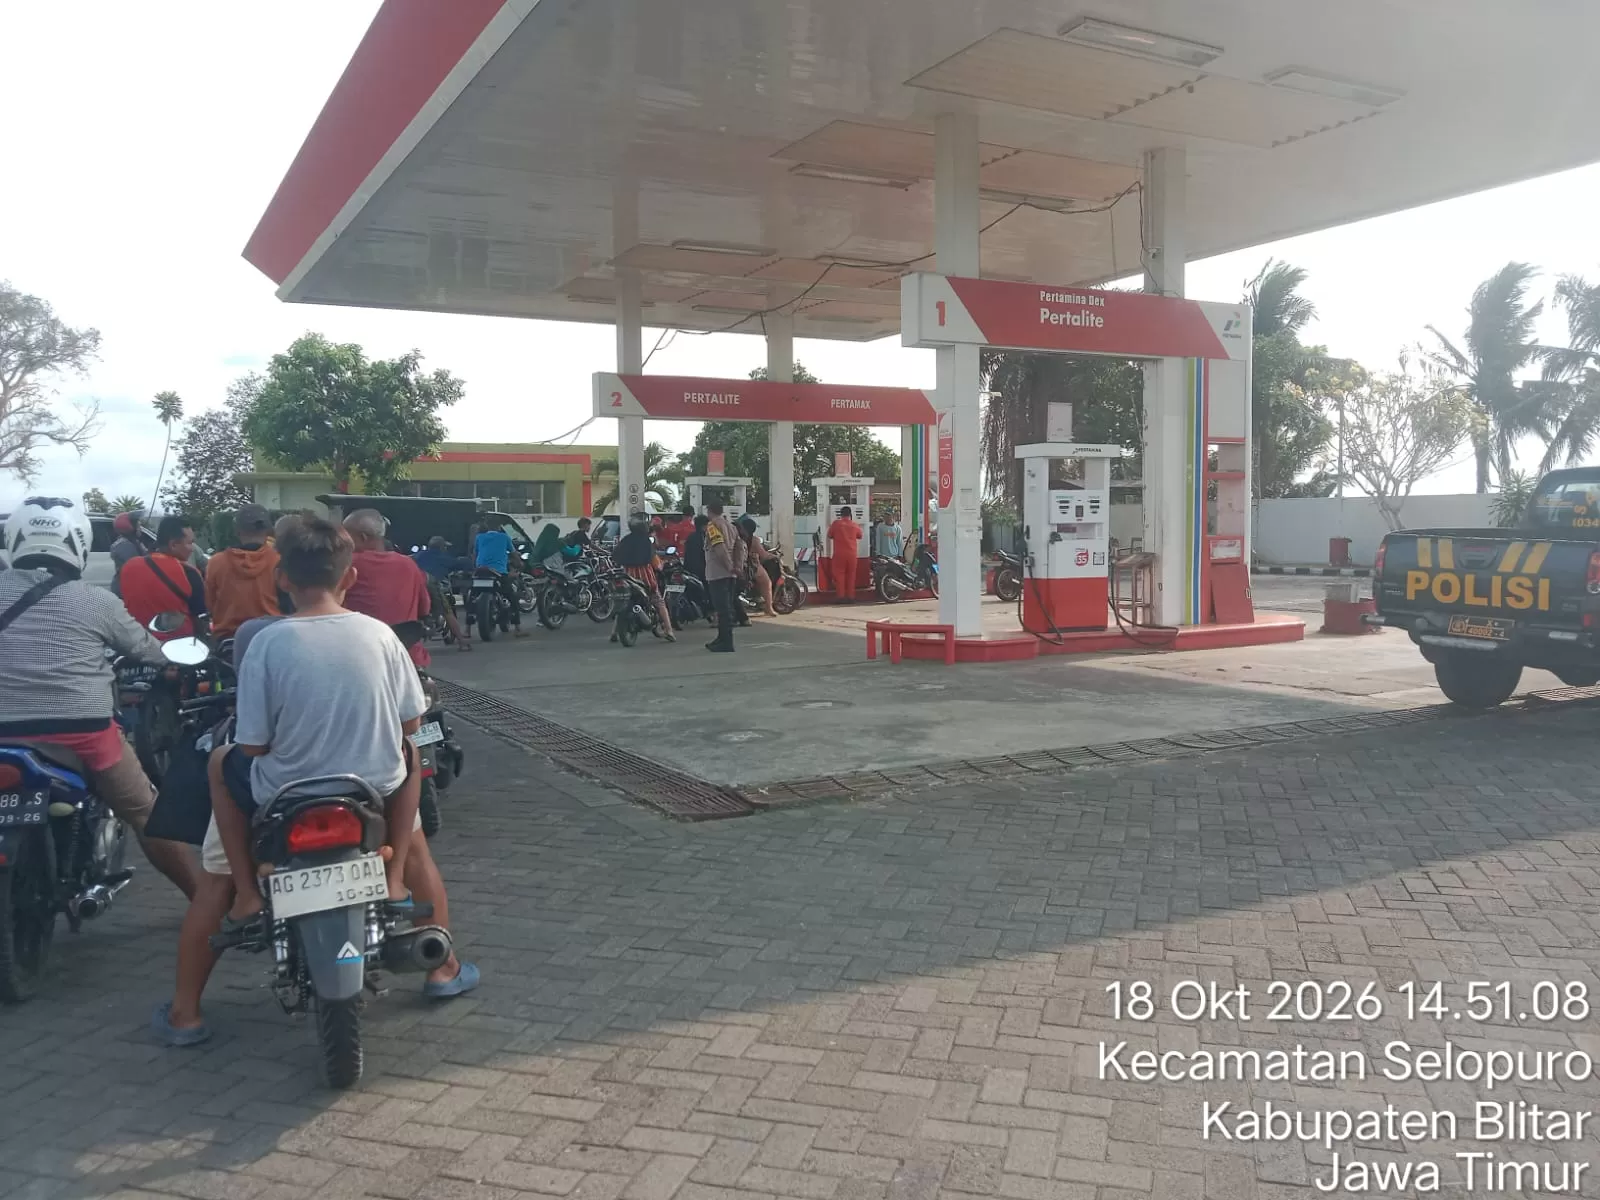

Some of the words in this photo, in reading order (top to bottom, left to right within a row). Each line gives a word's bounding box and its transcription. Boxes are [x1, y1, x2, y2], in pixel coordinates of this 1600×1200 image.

[1040, 290, 1086, 305] Pertamina
[1088, 295, 1105, 307] Dex
[936, 301, 946, 326] 1
[1040, 308, 1104, 328] Pertalite
[610, 391, 623, 407] 2
[683, 392, 740, 405] PERTALITE
[830, 398, 871, 410] PERTAMAX
[1406, 571, 1550, 611] POLISI
[34, 791, 43, 805] S
[272, 874, 294, 895] AG
[300, 866, 345, 890] 2373
